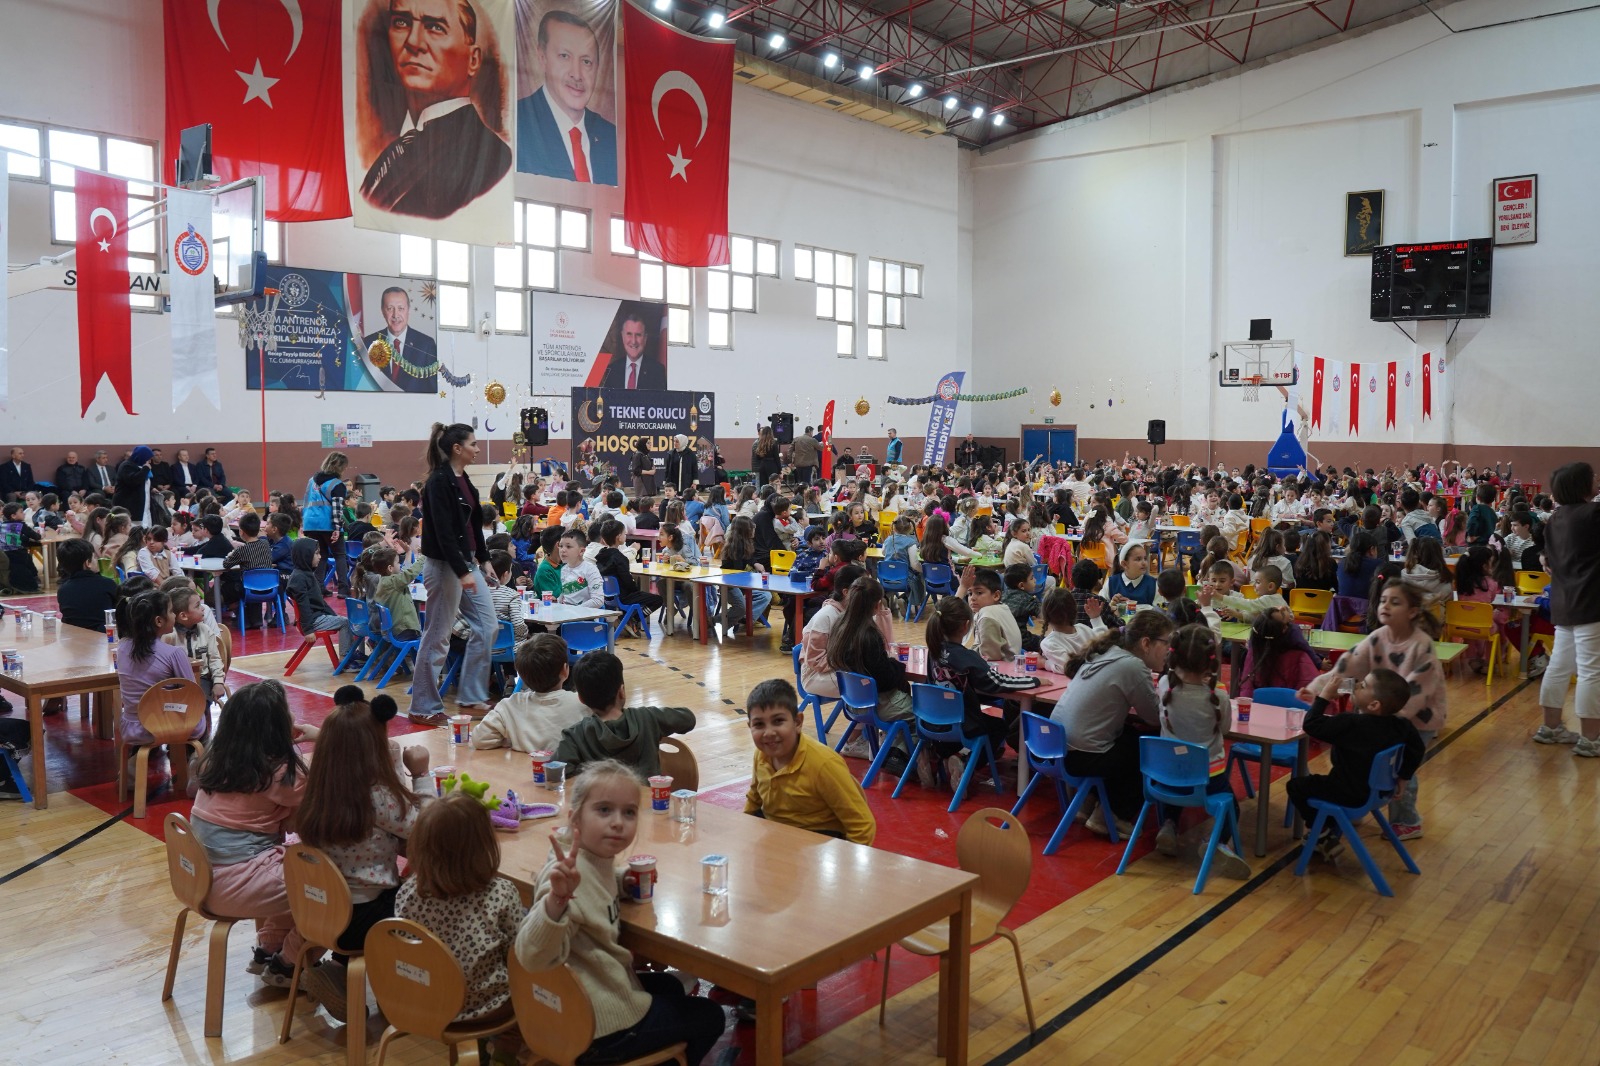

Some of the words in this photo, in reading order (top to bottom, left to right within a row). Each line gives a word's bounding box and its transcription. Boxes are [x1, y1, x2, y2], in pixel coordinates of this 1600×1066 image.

[282, 316, 328, 326] ANTRENÖR
[608, 406, 646, 419] TEKNE
[647, 406, 686, 420] ORUCU
[618, 420, 636, 430] İFTAR
[636, 422, 676, 430] PROGRAMINA
[923, 404, 944, 467] ORHANGAZİ
[934, 407, 954, 468] BELEDİYESİ
